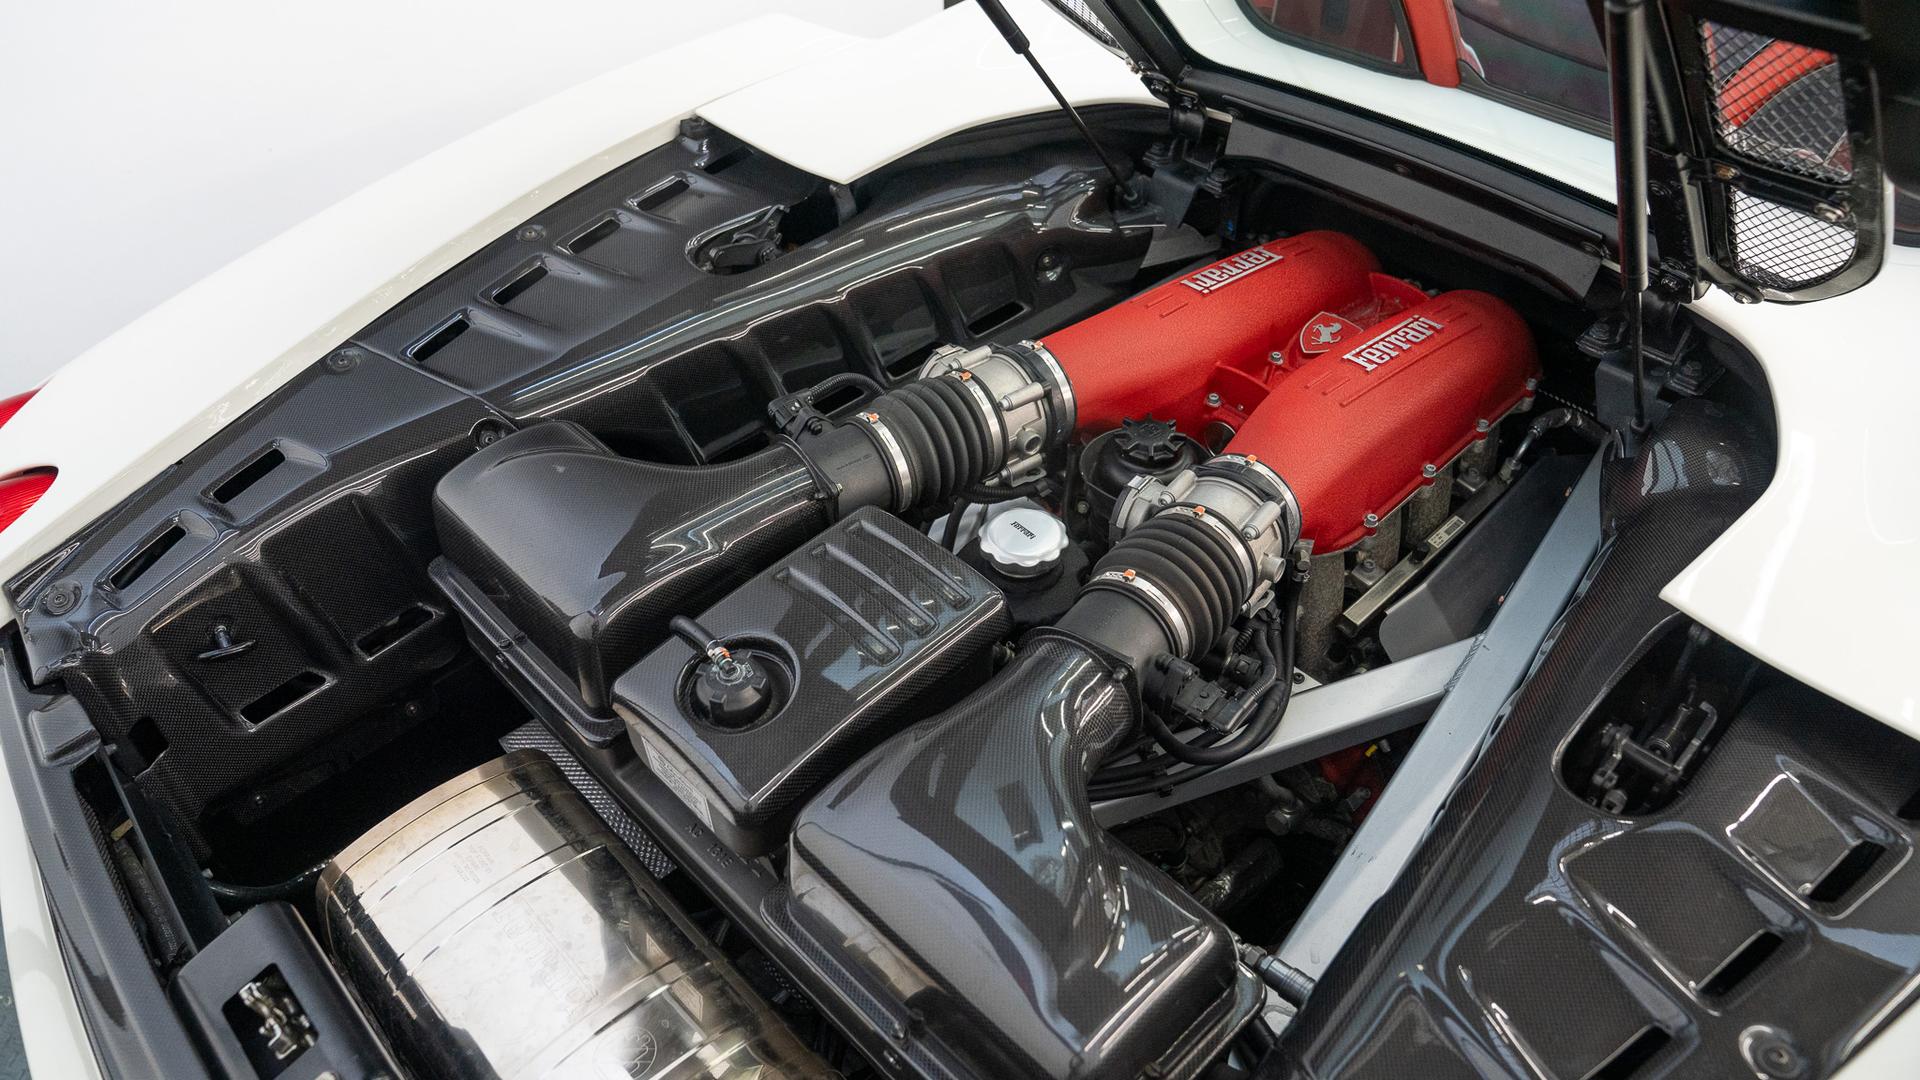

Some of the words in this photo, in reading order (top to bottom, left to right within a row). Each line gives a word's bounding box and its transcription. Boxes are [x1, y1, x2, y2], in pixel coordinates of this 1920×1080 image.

[1180, 246, 1284, 293] Ferrari
[1342, 314, 1444, 372] Ferrari
[1010, 521, 1036, 539] Ferrari
